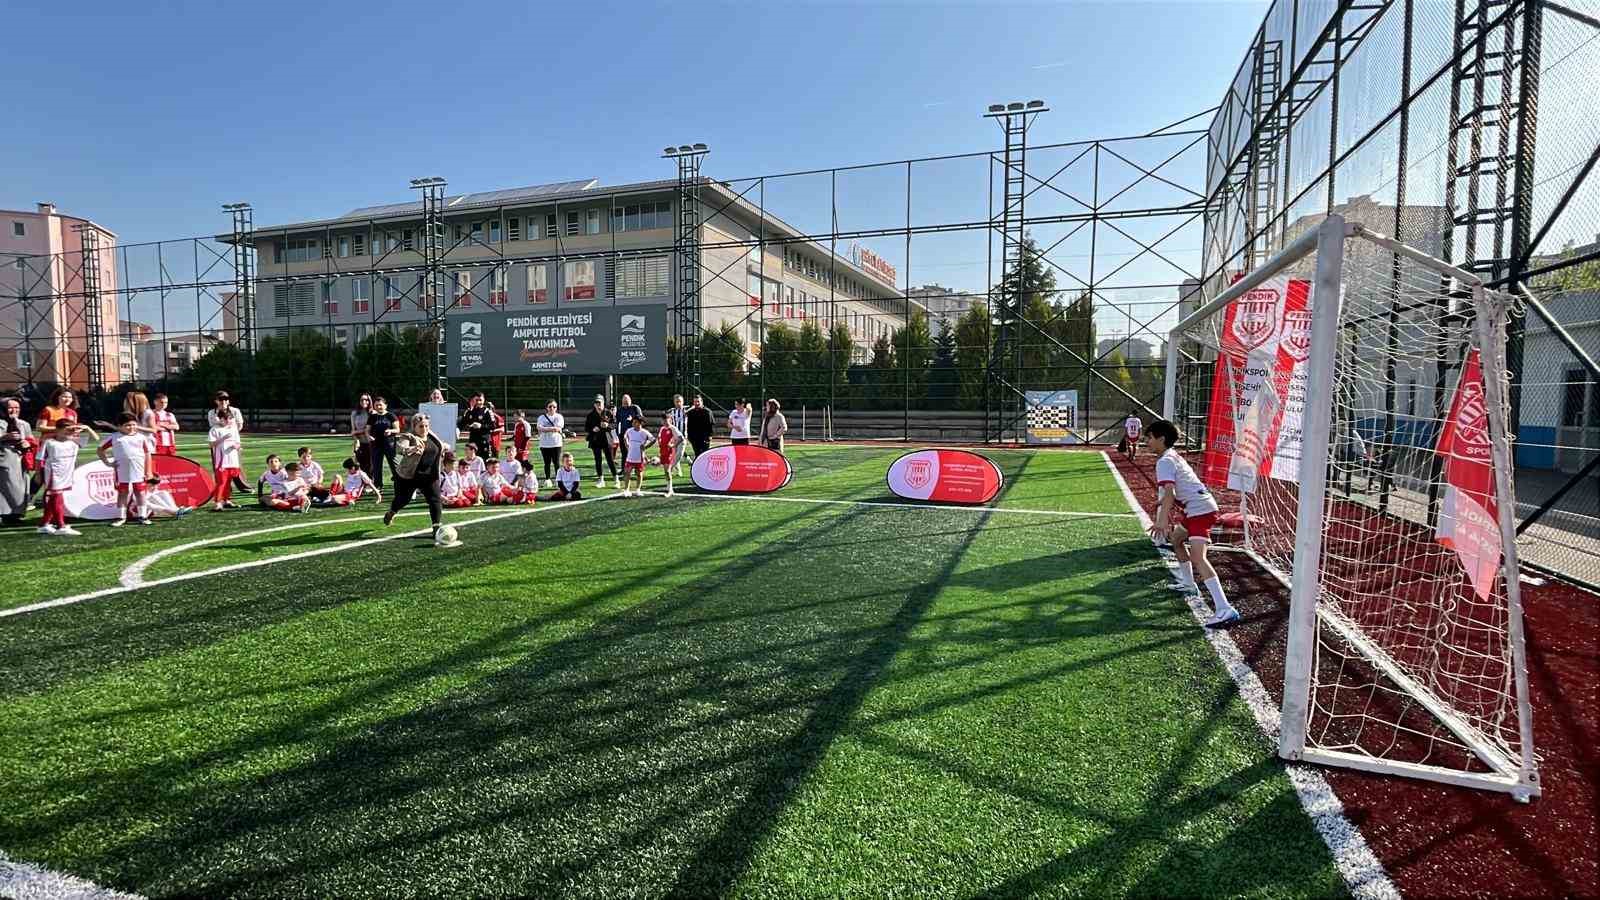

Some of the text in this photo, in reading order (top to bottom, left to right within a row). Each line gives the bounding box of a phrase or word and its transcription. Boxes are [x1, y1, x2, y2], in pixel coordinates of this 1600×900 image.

[506, 312, 592, 327] PENDİK BELEDİYESİ
[512, 326, 587, 339] AMPUTE FUTBOL
[522, 338, 576, 350] TAKIMIMIZA
[1465, 446, 1491, 456] SPO
